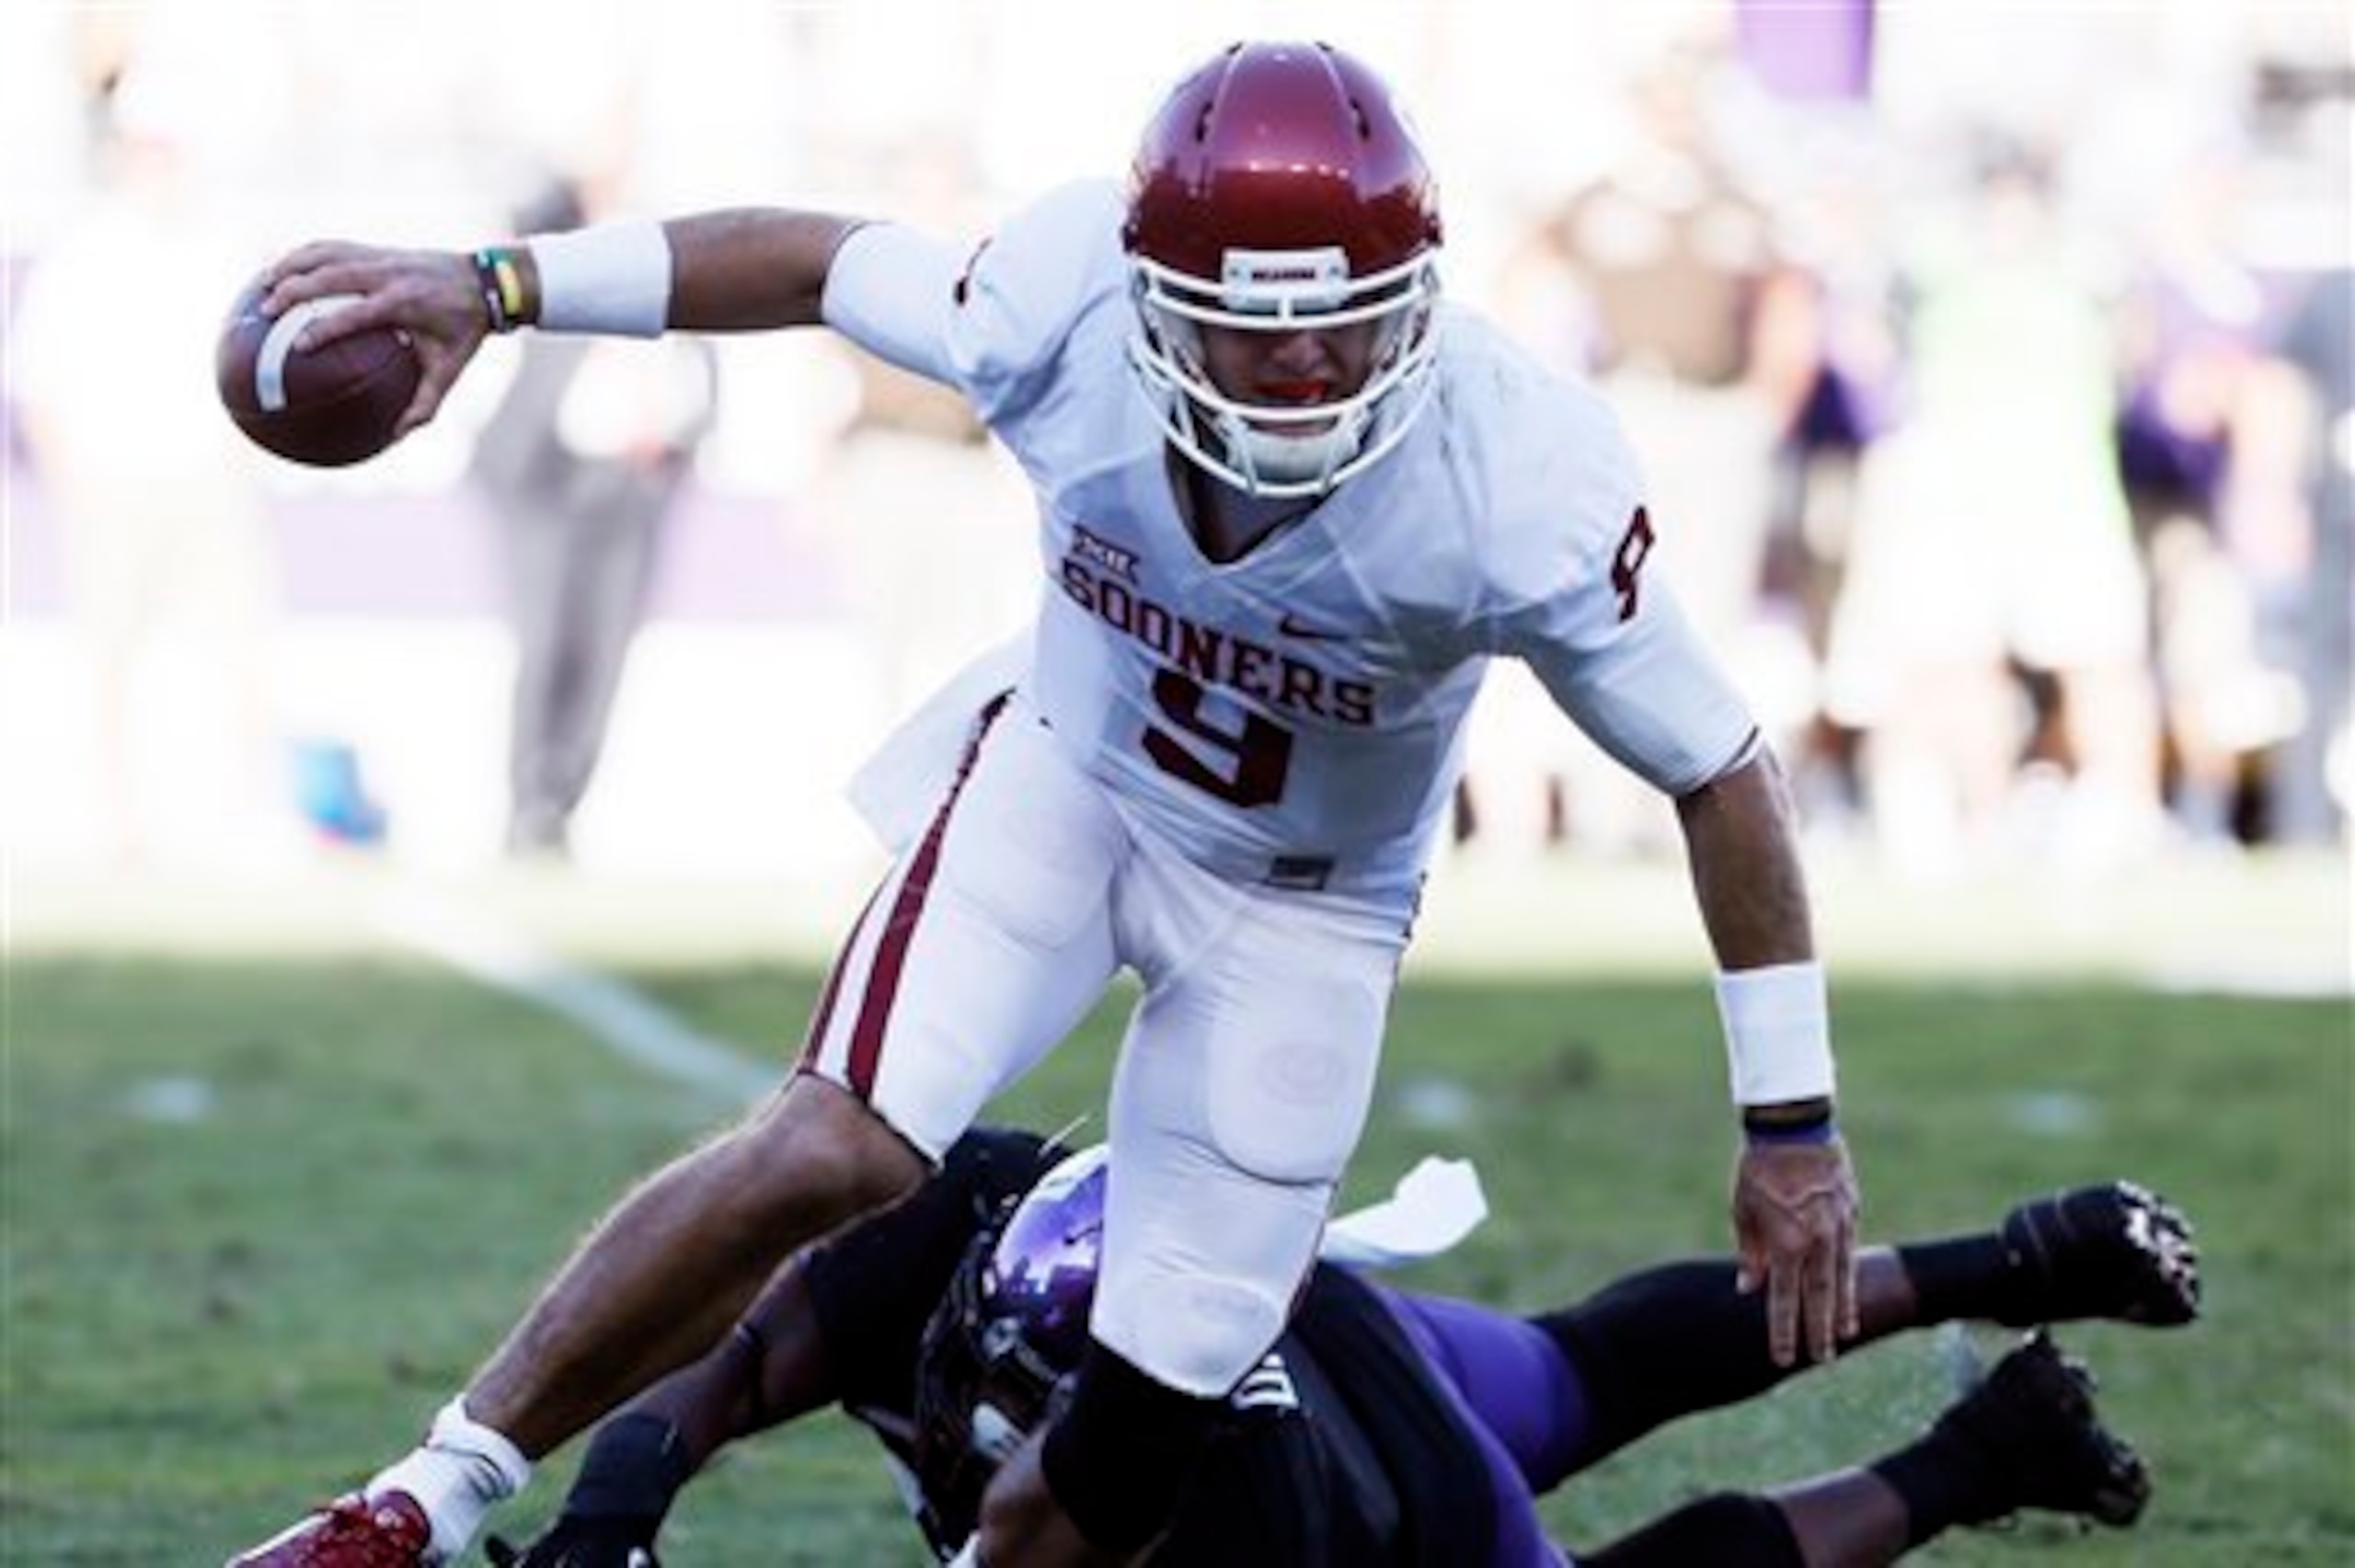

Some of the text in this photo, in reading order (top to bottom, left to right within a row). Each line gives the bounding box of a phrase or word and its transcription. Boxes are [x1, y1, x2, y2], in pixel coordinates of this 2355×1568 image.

[1612, 506, 1655, 624] 9
[1062, 556, 1378, 727] SOONERS
[1141, 667, 1294, 808] 9
